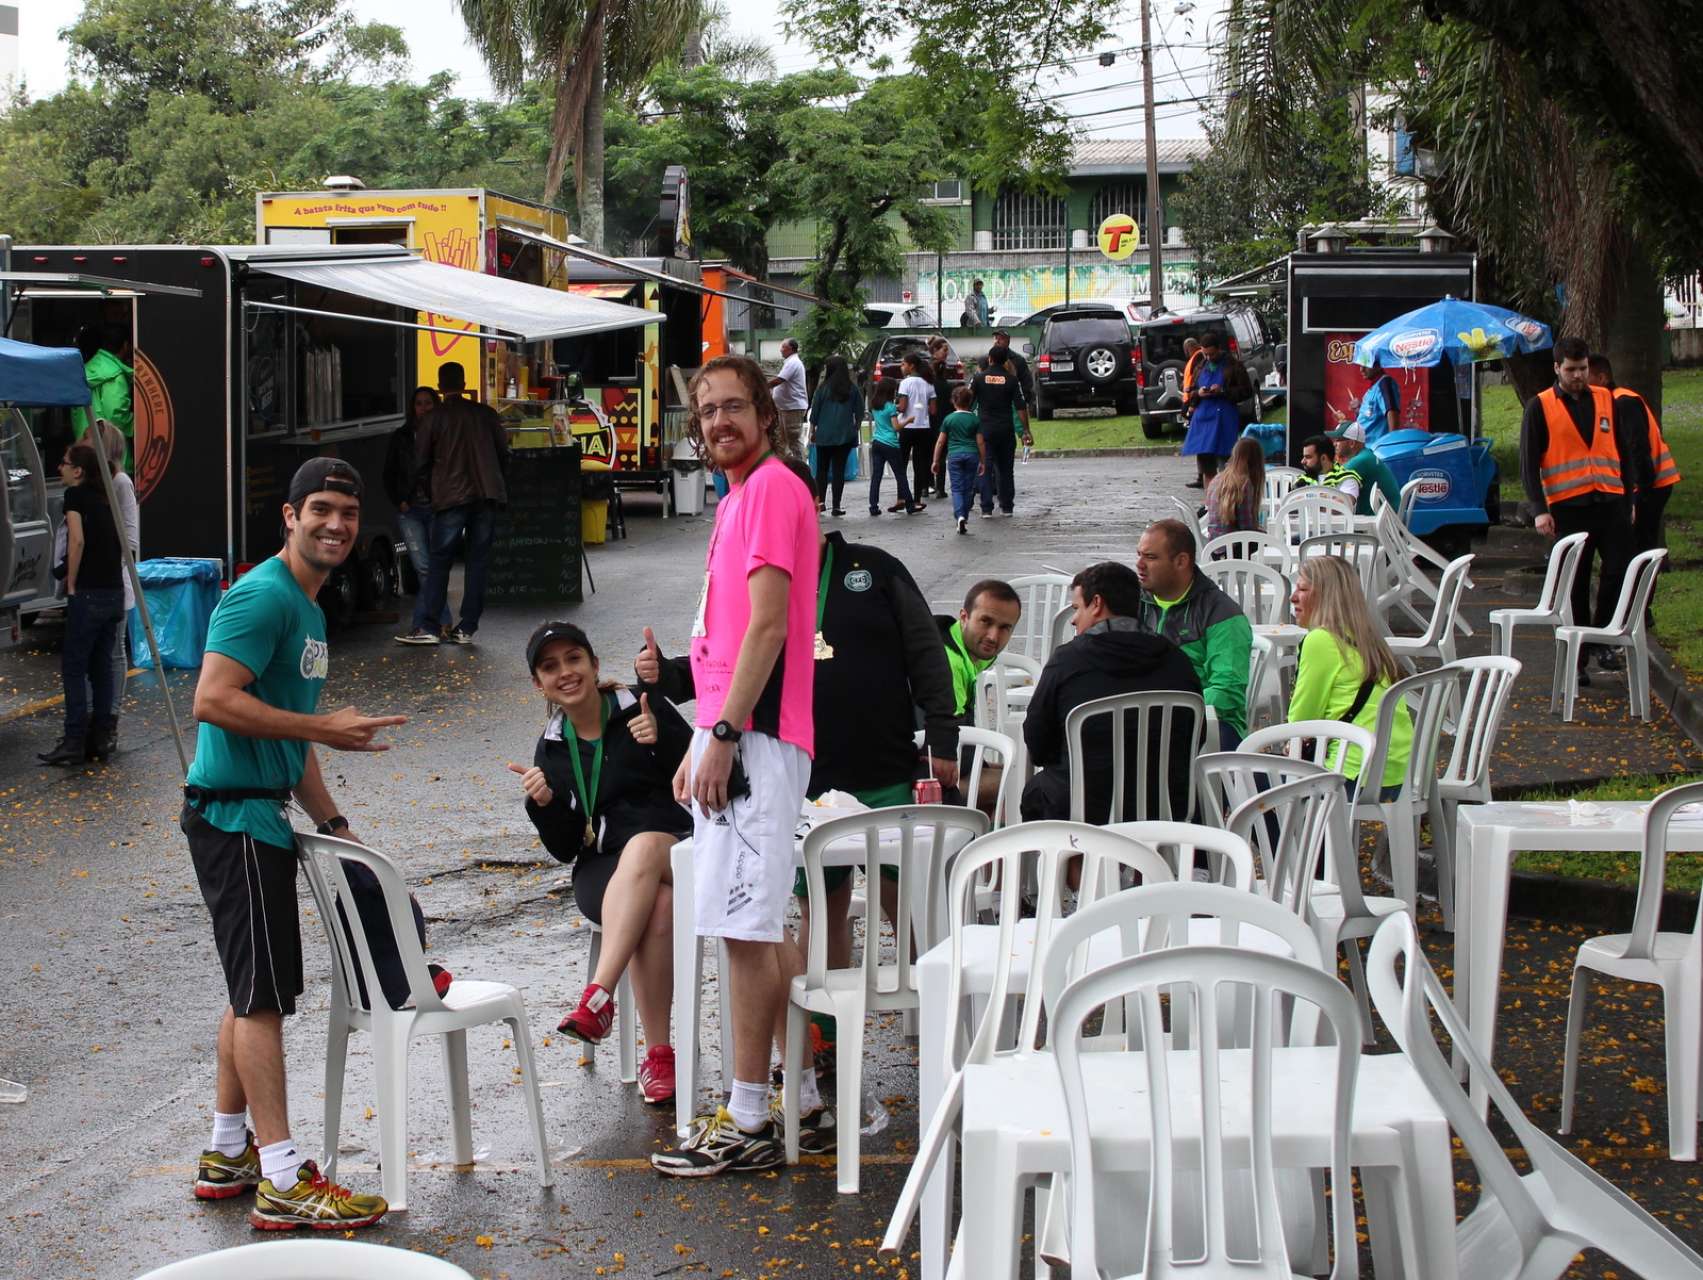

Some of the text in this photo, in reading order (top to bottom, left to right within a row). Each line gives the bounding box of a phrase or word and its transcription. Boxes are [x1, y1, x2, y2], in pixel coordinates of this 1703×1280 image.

[303, 204, 333, 215] batata
[335, 203, 357, 214] frita
[358, 205, 375, 216] que
[377, 202, 396, 213] vem
[397, 201, 416, 213] com
[418, 201, 439, 213] tudo
[1104, 225, 1134, 253] T
